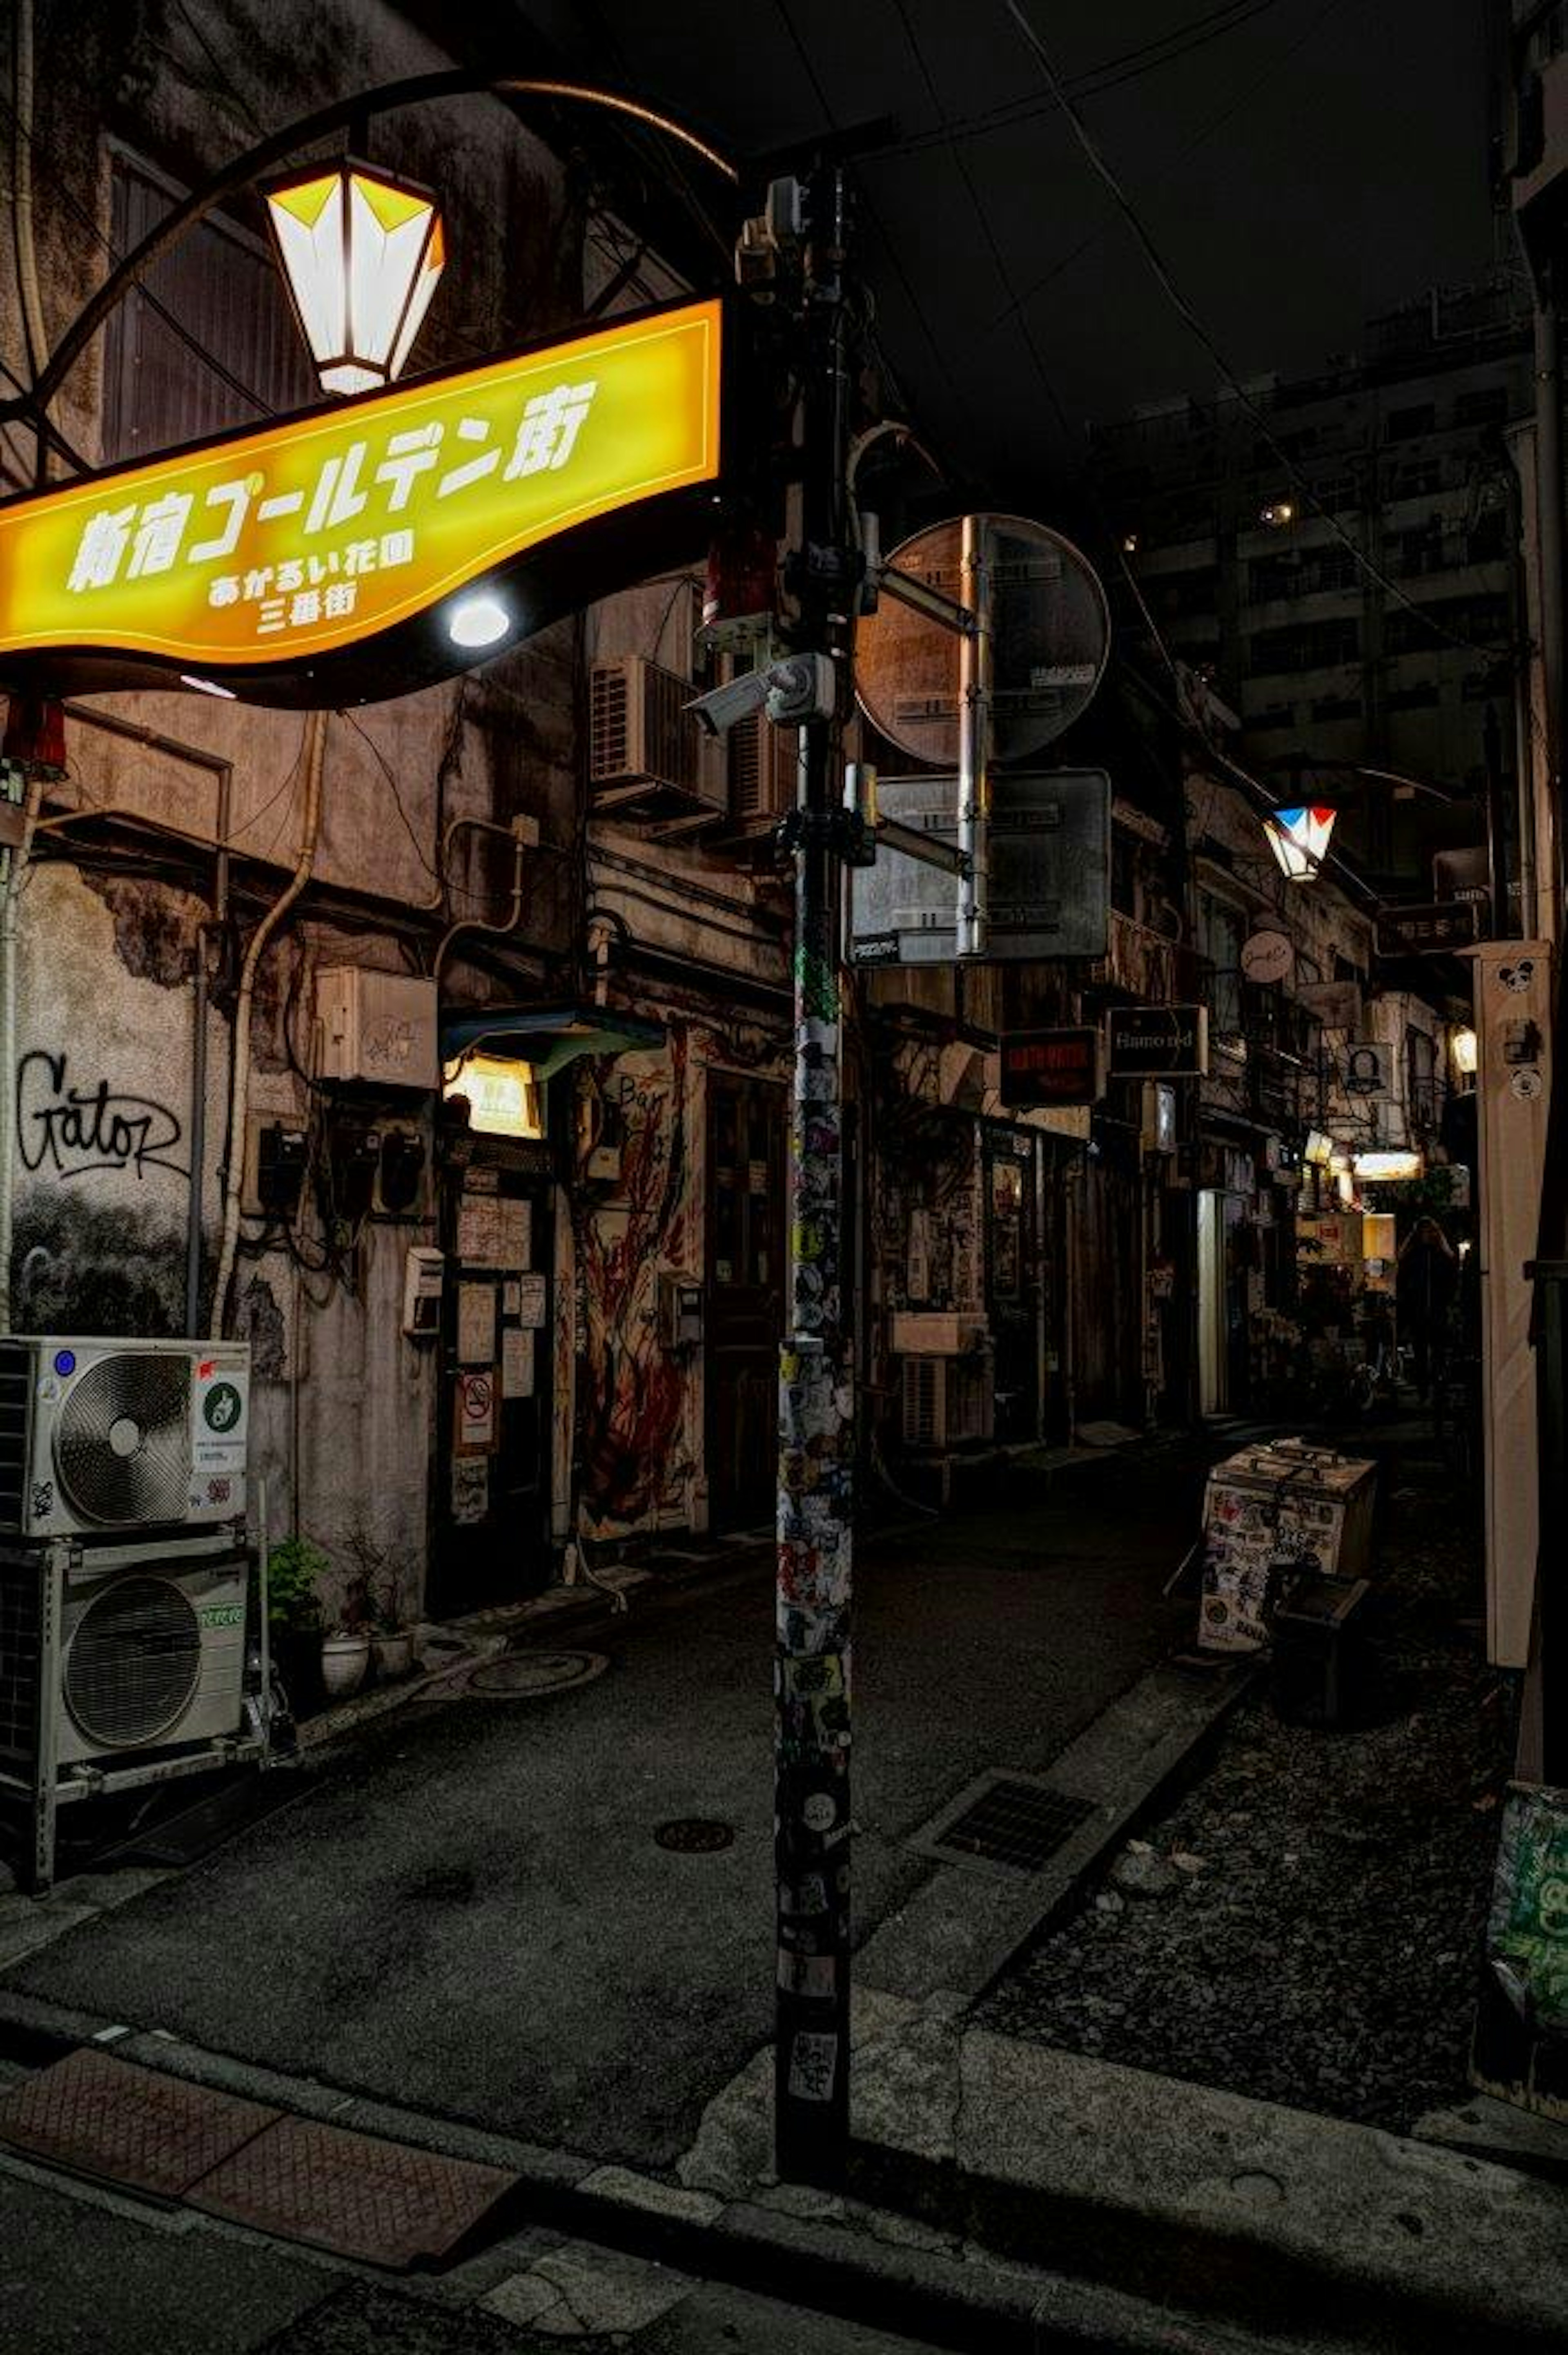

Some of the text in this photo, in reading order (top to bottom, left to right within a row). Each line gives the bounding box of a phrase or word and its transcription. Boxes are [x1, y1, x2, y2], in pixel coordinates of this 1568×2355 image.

[68, 381, 598, 592] 新宿ゴールデン街
[209, 529, 414, 607] あかるい花園
[256, 580, 358, 634] 三番街
